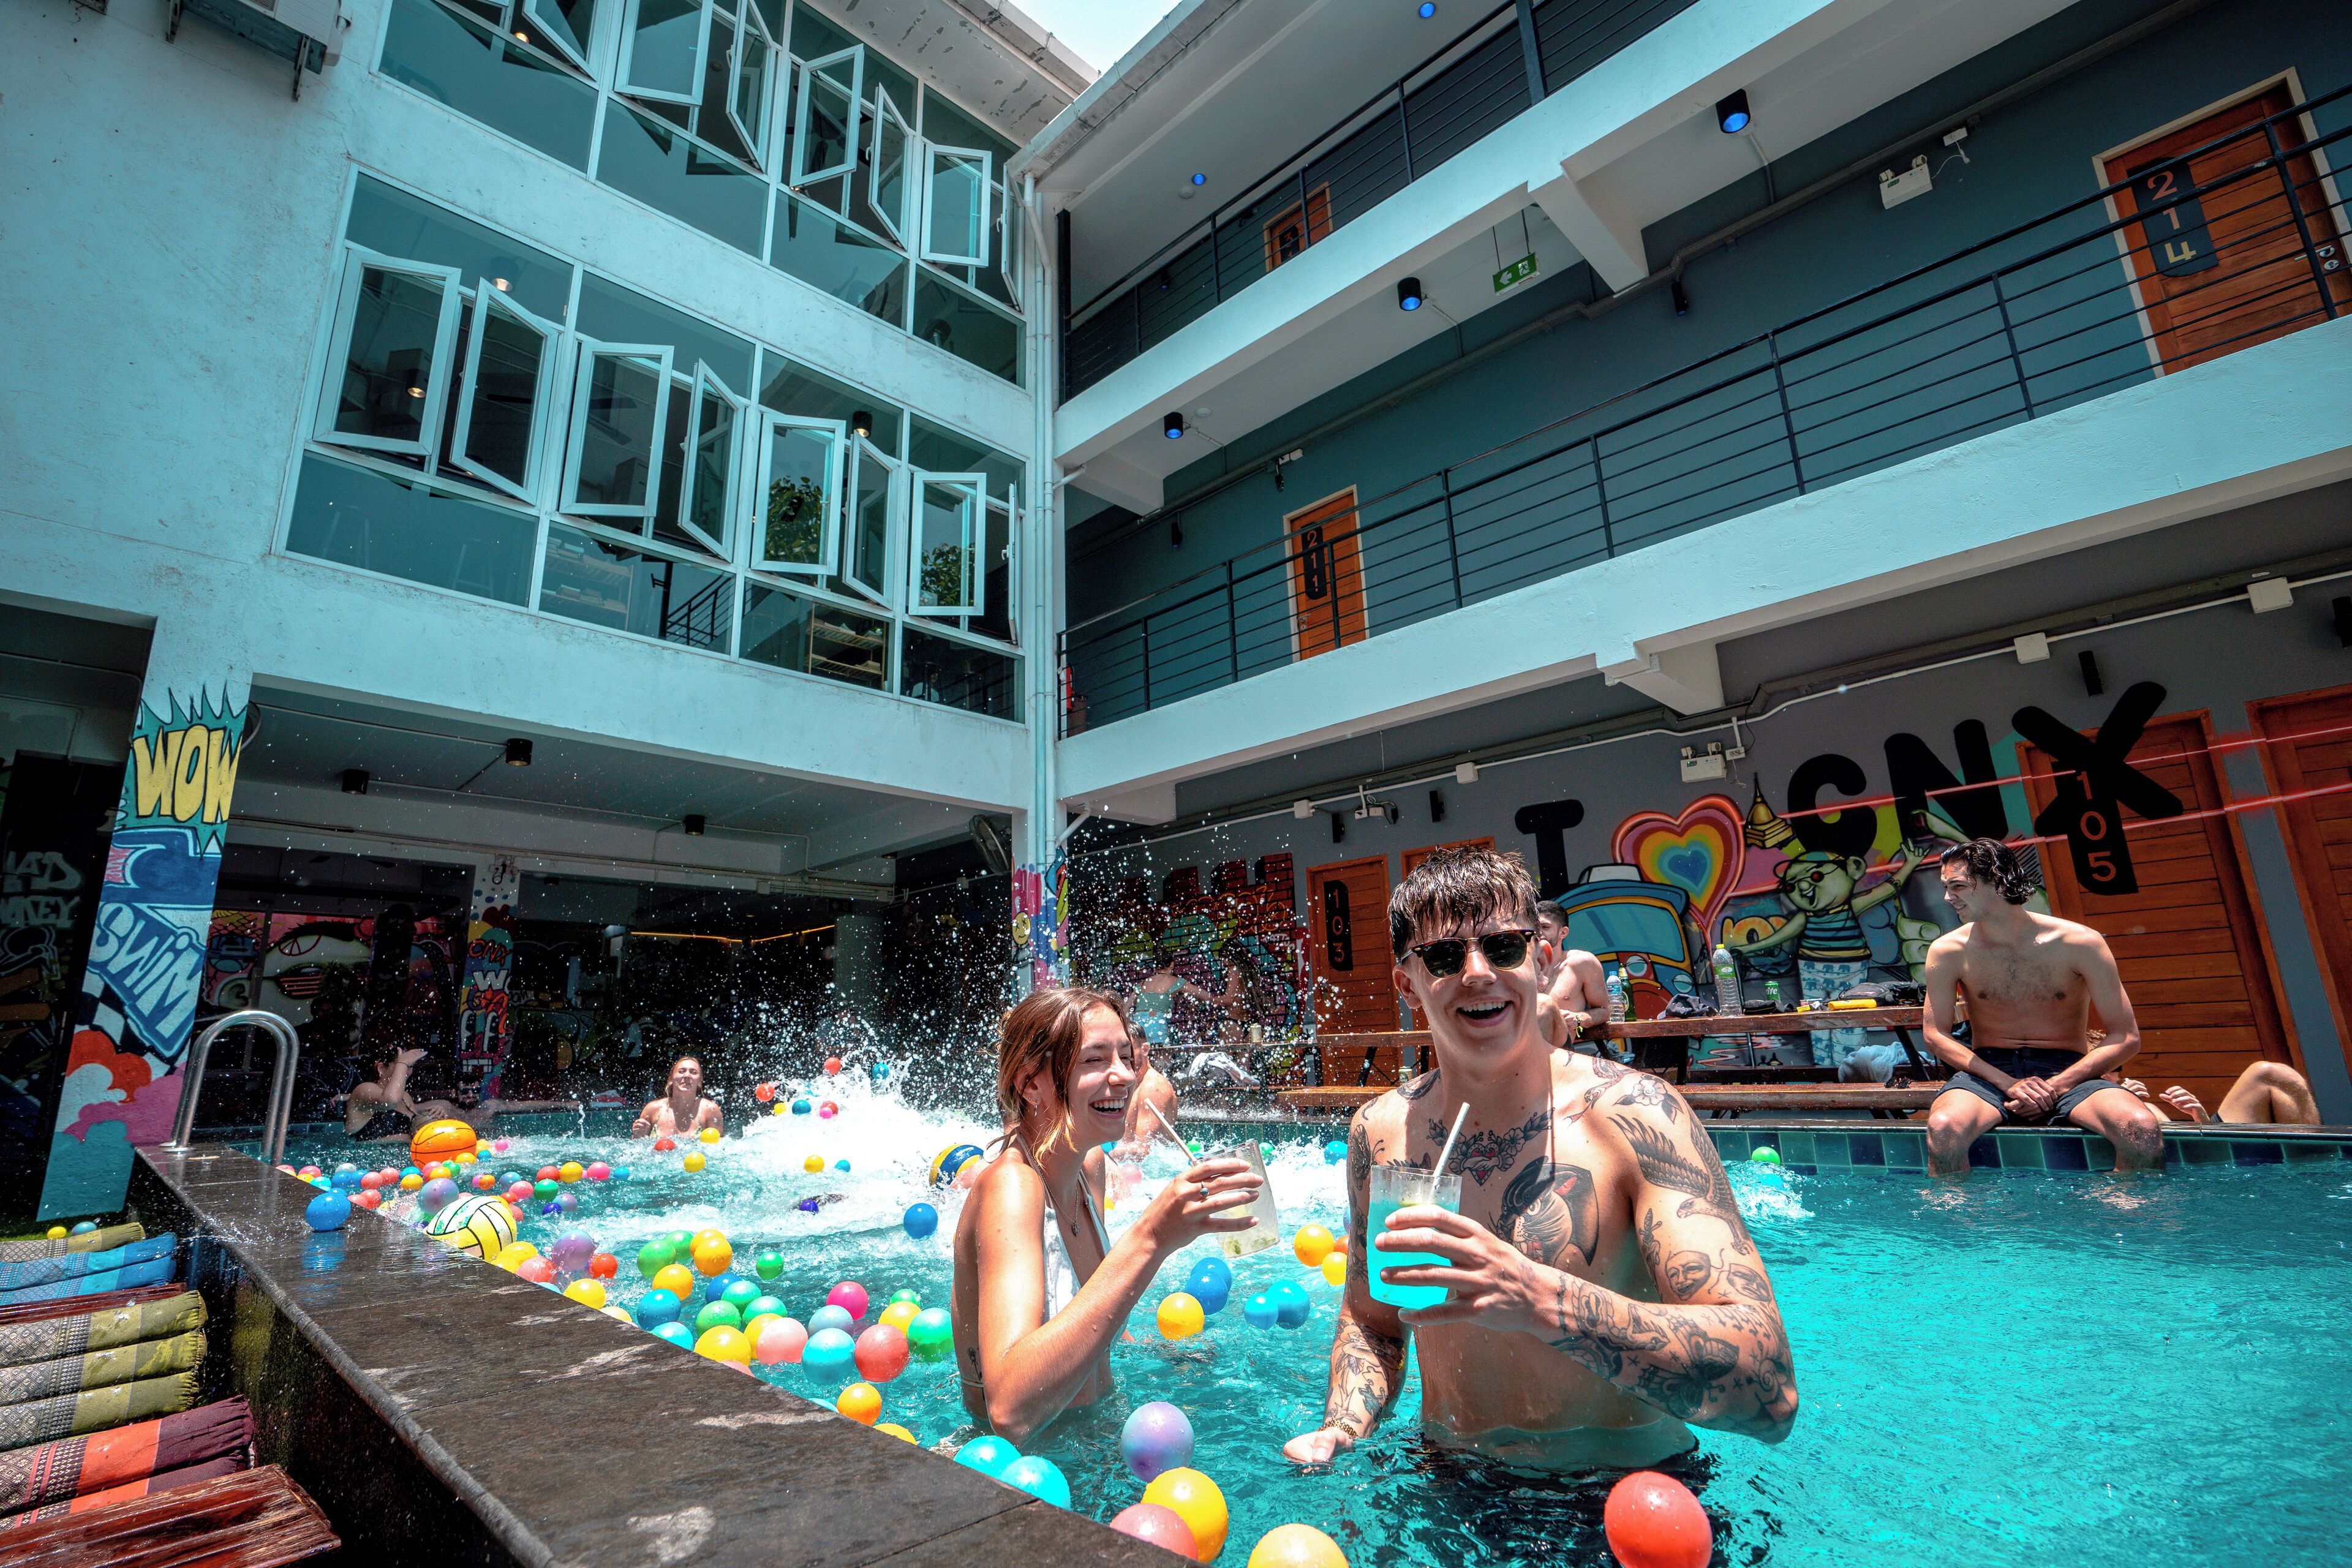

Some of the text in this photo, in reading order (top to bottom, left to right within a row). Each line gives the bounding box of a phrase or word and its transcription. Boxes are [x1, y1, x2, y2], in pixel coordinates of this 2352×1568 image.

[2147, 171, 2197, 264] 214
[1306, 529, 1319, 592] 211
[132, 723, 243, 824] WOW
[2076, 771, 2117, 882] 105
[1332, 889, 1345, 963] 103
[1766, 987, 1778, 995] ite
